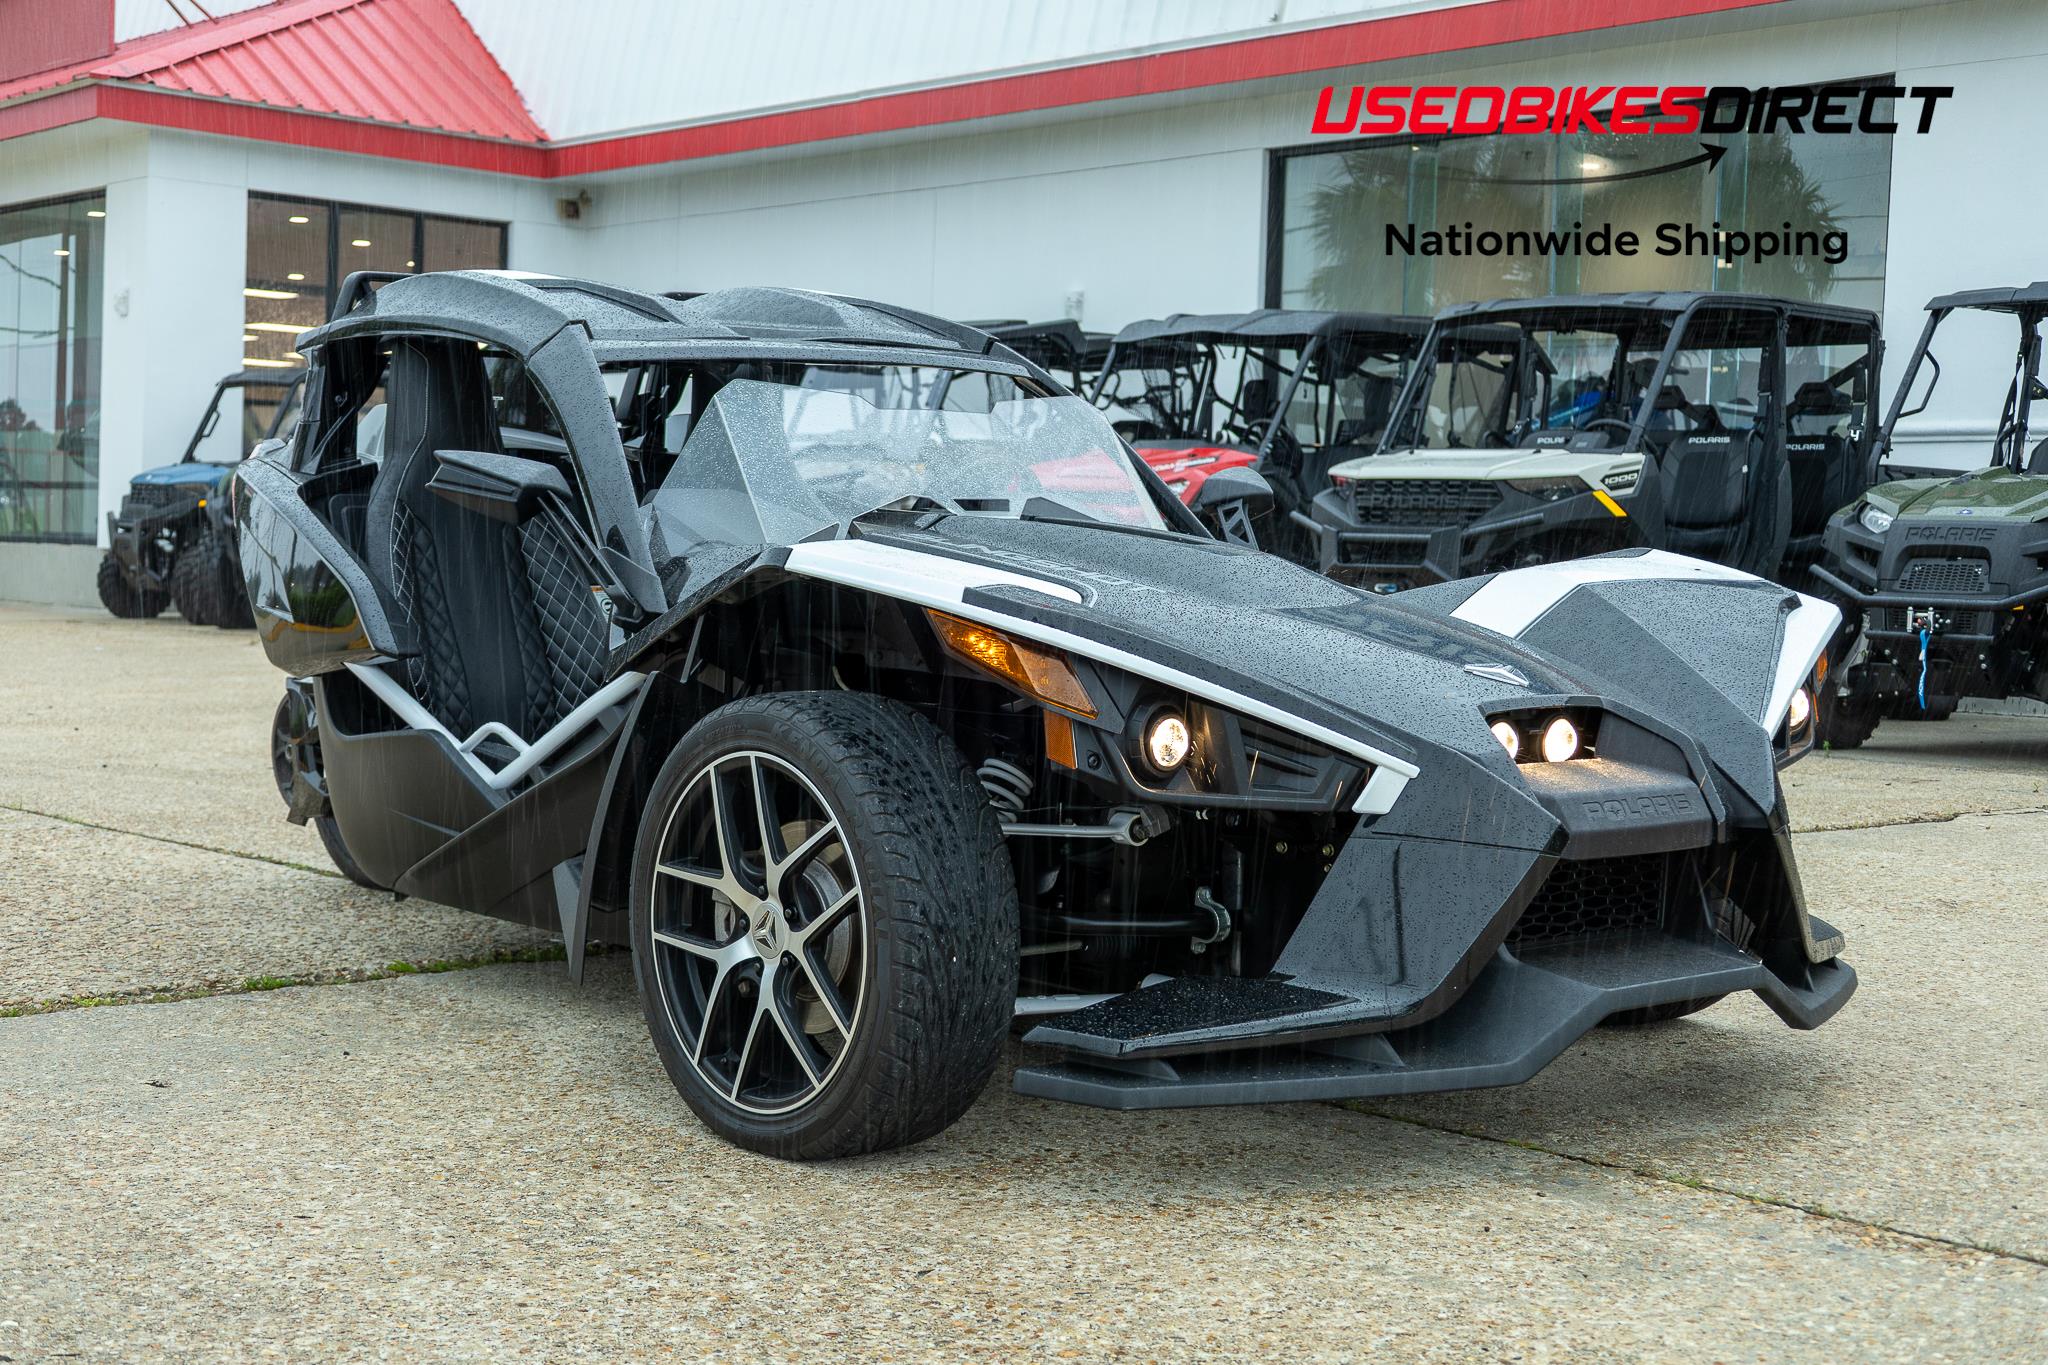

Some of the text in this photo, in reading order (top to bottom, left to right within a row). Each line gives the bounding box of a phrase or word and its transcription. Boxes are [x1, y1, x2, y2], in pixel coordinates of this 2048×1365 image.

[1688, 436, 1731, 444] POLARIS
[1785, 443, 1825, 451] POLARIS
[1604, 472, 1638, 485] 1000
[1371, 494, 1459, 508] POLARIS
[1904, 526, 1998, 542] POLARIS
[1582, 793, 1694, 822] POLARIS
